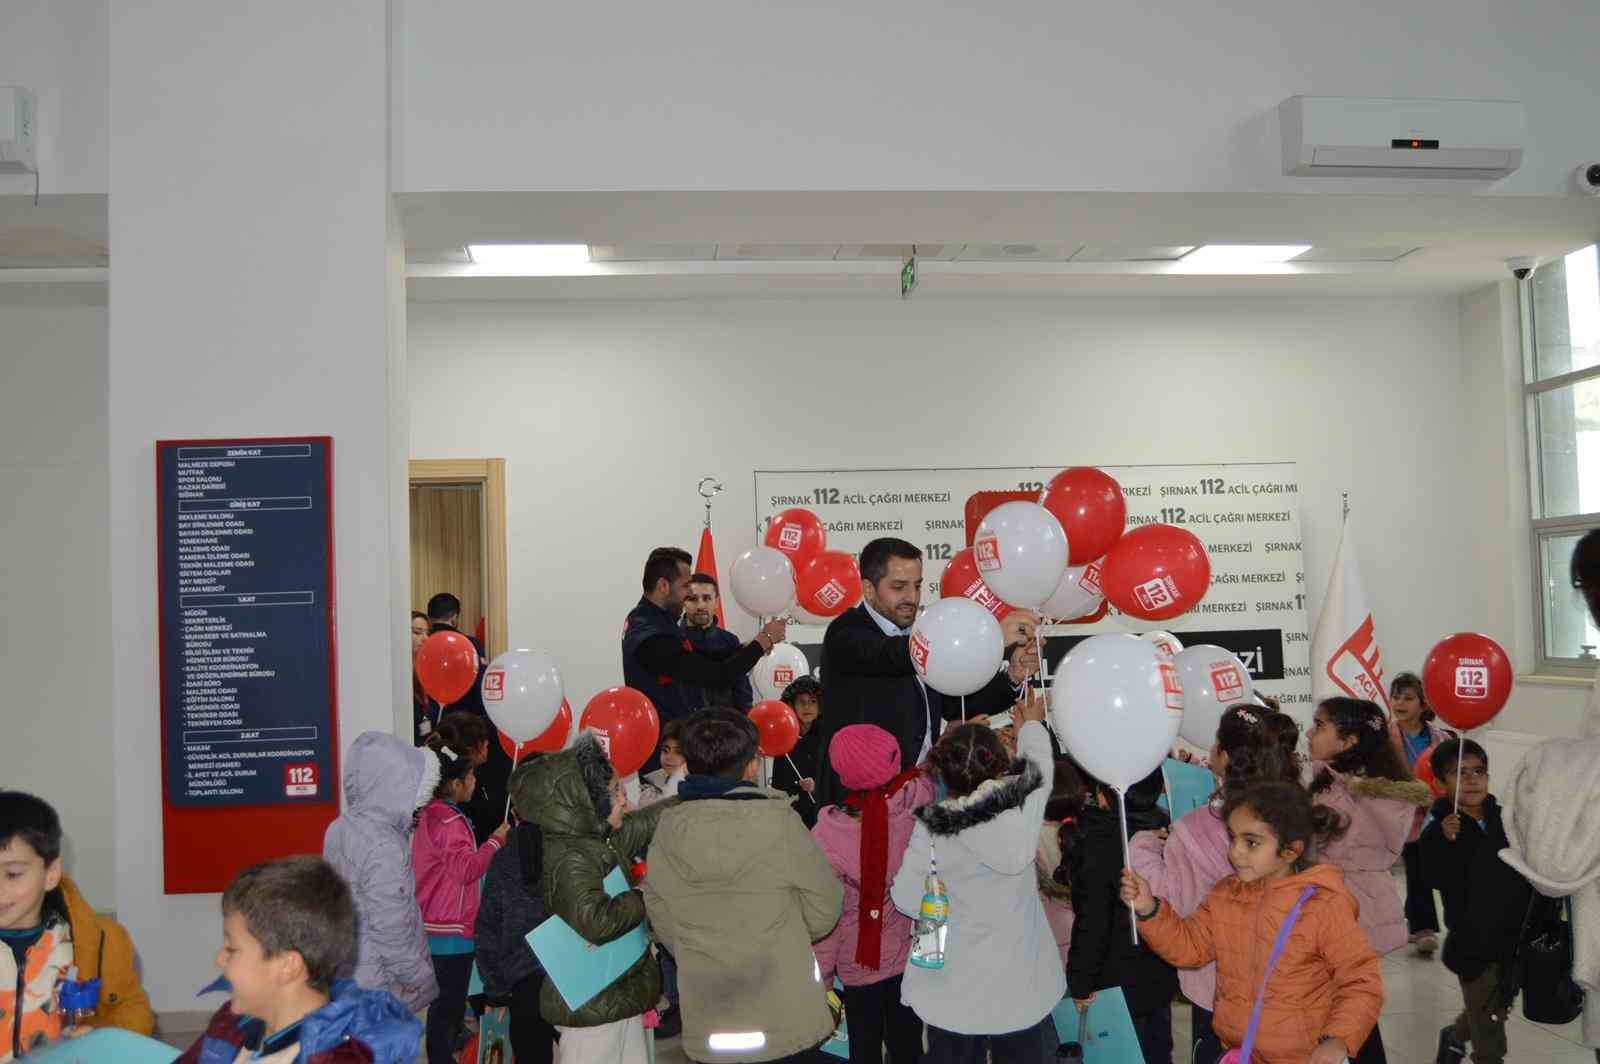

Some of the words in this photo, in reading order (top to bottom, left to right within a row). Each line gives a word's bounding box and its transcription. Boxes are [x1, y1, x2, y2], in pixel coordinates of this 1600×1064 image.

[1160, 486, 1198, 498] ŞIRNAK
[1200, 479, 1225, 494] 112
[1228, 482, 1250, 494] ACİL
[1252, 482, 1283, 496] ÇAĞRI
[771, 496, 812, 506] ŞIRNAK
[814, 488, 840, 505] 112
[843, 493, 866, 504] ACİL
[869, 491, 901, 506] ÇAĞRI
[904, 491, 950, 503] MERKEZİ
[1161, 508, 1186, 524] 112
[1189, 512, 1211, 523] ACİL
[1213, 512, 1244, 525] ÇAĞRI
[1247, 511, 1291, 522] MERKEZİ
[857, 520, 903, 531] MERKEZİ
[925, 520, 964, 531] ŞIRNAK
[782, 529, 798, 541] 112
[926, 544, 951, 560] 112
[976, 543, 994, 559] 112
[1208, 542, 1252, 553] MERKEZİ
[1265, 542, 1302, 554] ŞIRNAK
[1242, 571, 1285, 583] MERKEZİ
[822, 584, 840, 601] 112
[1147, 584, 1167, 604] 112
[1202, 602, 1247, 613] MERKEZİ
[1256, 602, 1293, 612] ŞIRNAK
[486, 677, 501, 689] 112
[776, 672, 792, 681] 112
[1216, 673, 1235, 687] 112
[1460, 670, 1483, 685] 112
[289, 767, 314, 783] 112
